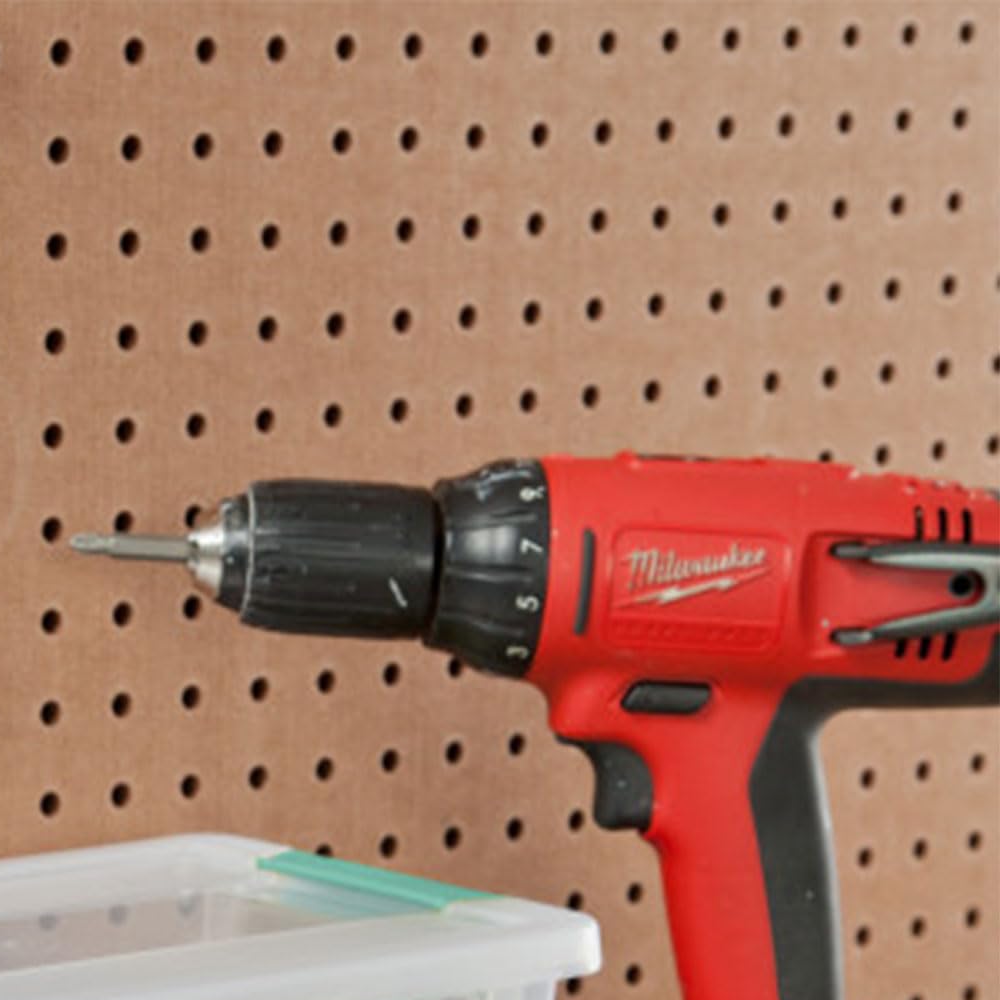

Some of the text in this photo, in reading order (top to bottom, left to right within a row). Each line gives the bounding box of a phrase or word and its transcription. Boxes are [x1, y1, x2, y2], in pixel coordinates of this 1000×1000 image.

[520, 538, 544, 554] 7
[624, 543, 767, 591] Milwaukee
[516, 595, 540, 612] 5
